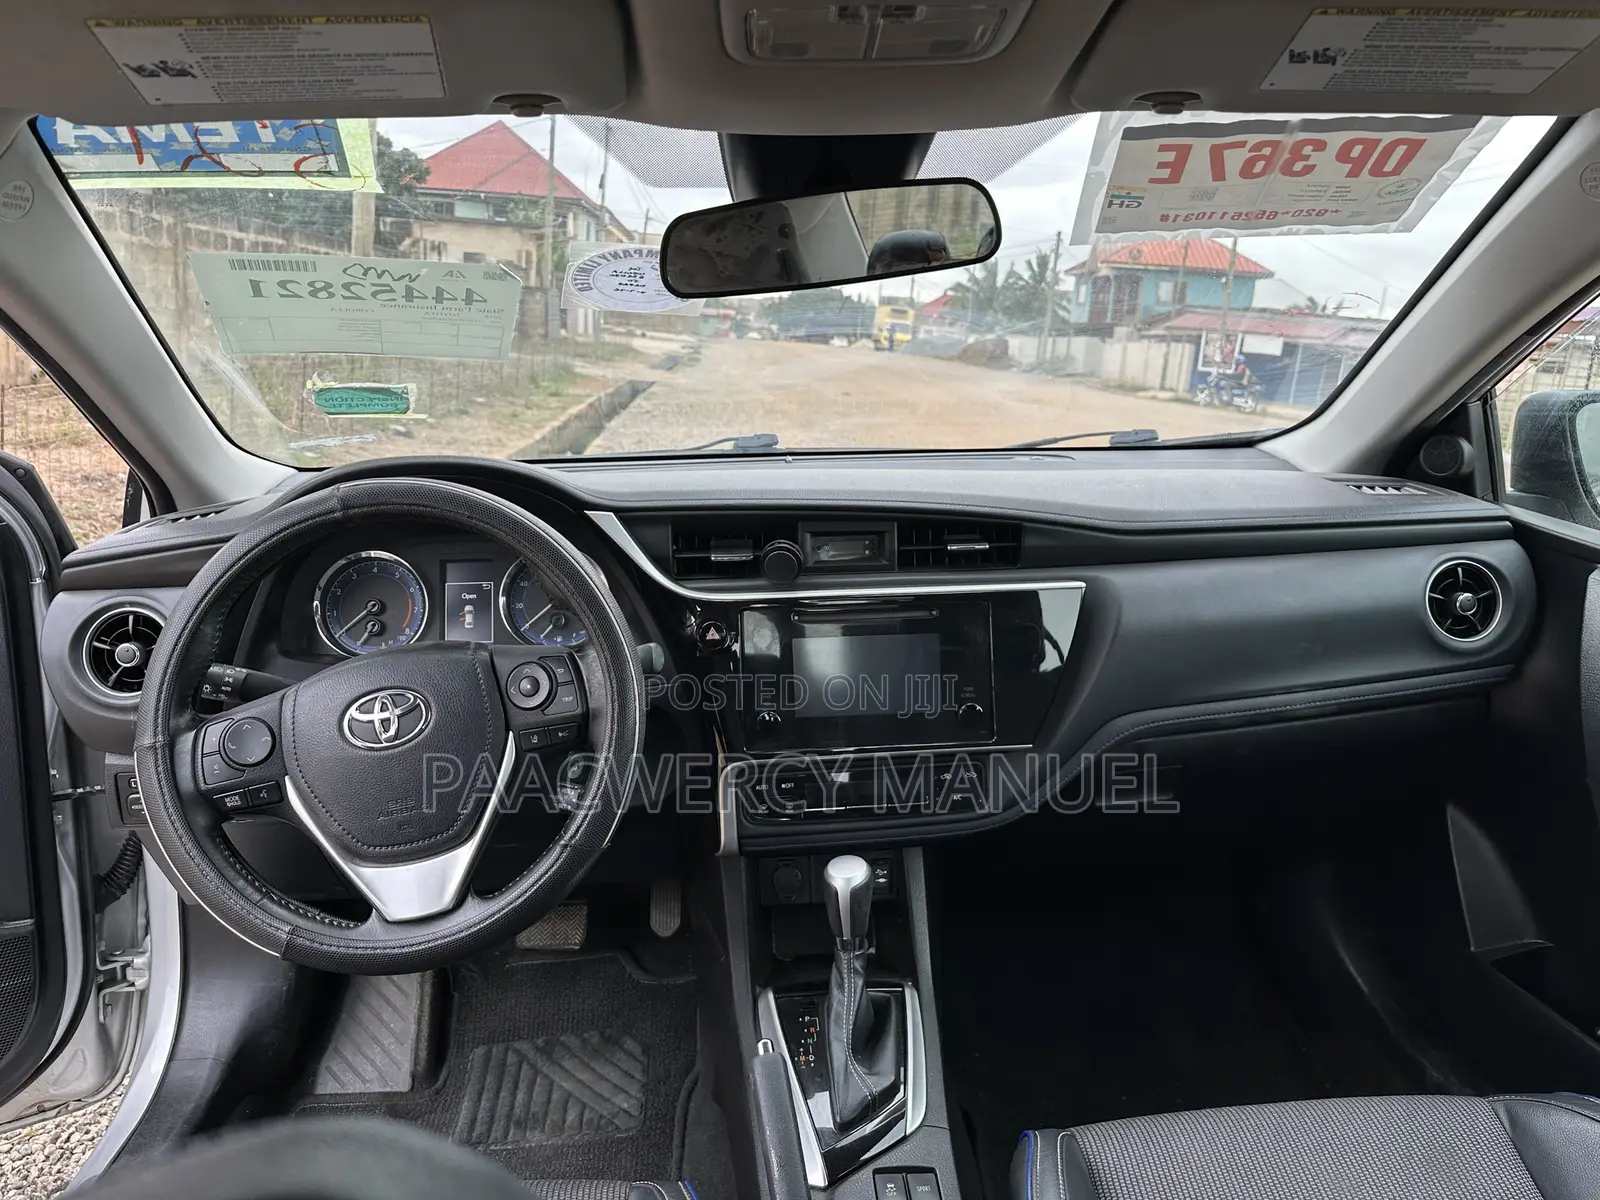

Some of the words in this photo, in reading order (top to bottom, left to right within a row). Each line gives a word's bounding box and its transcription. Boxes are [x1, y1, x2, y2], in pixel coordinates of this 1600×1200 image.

[461, 592, 477, 600] Open
[413, 606, 418, 614] 7
[224, 794, 240, 803] MODE
